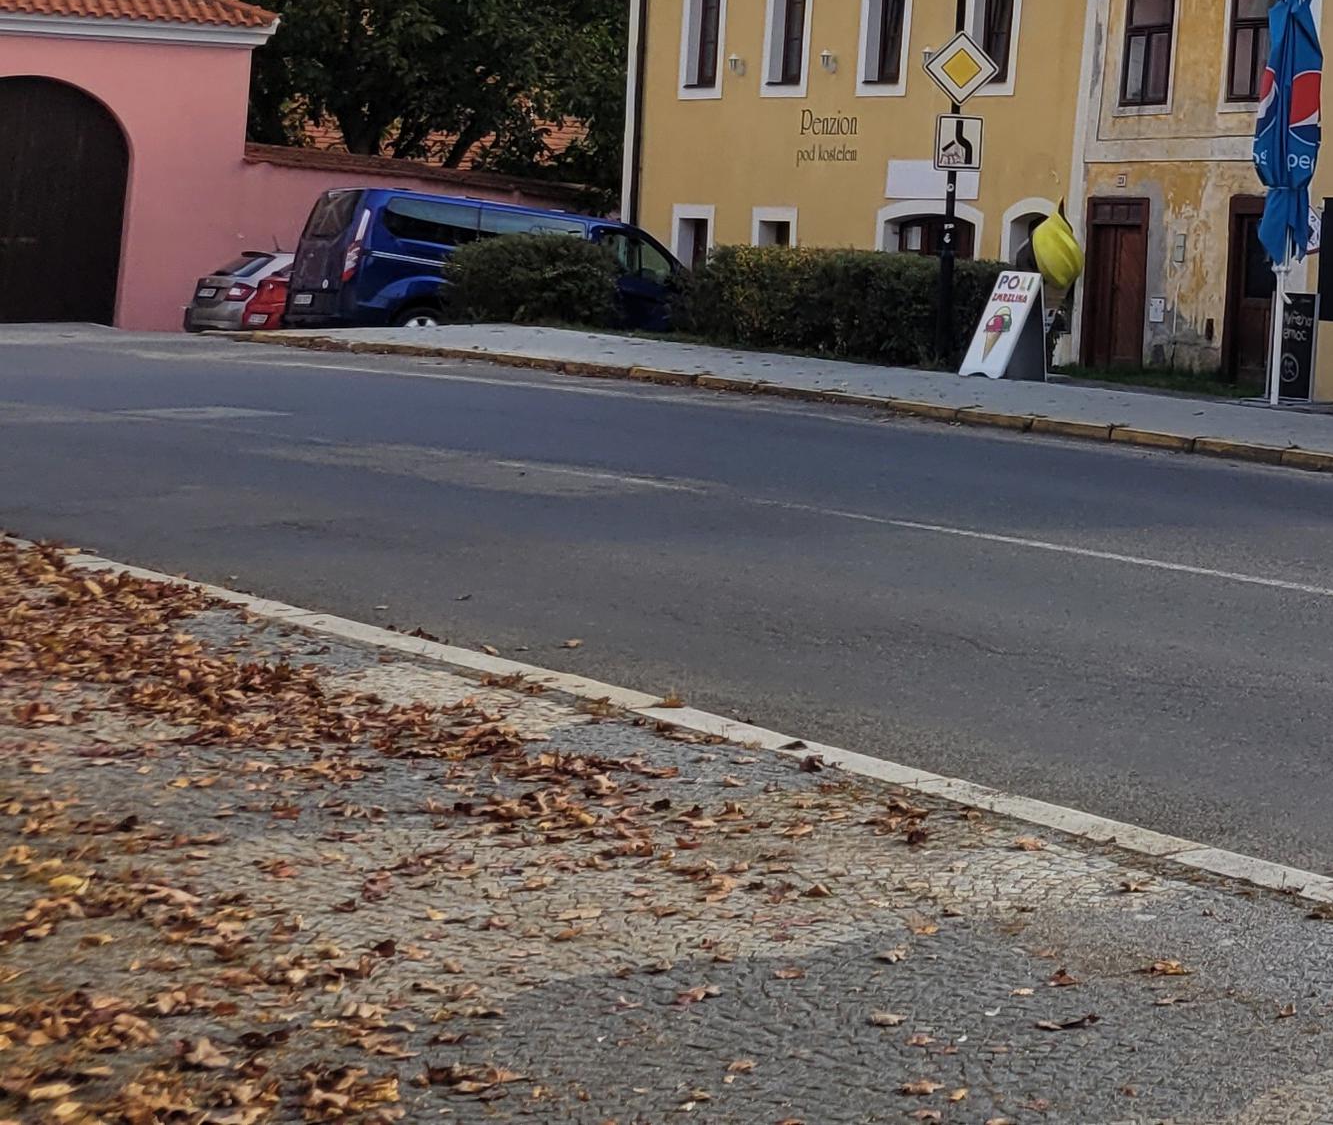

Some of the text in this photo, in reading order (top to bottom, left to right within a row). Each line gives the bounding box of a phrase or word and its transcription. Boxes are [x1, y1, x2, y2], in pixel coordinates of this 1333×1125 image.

[799, 108, 858, 136] Penzion
[796, 143, 857, 167] pod kostelem
[997, 275, 1035, 292] POLI
